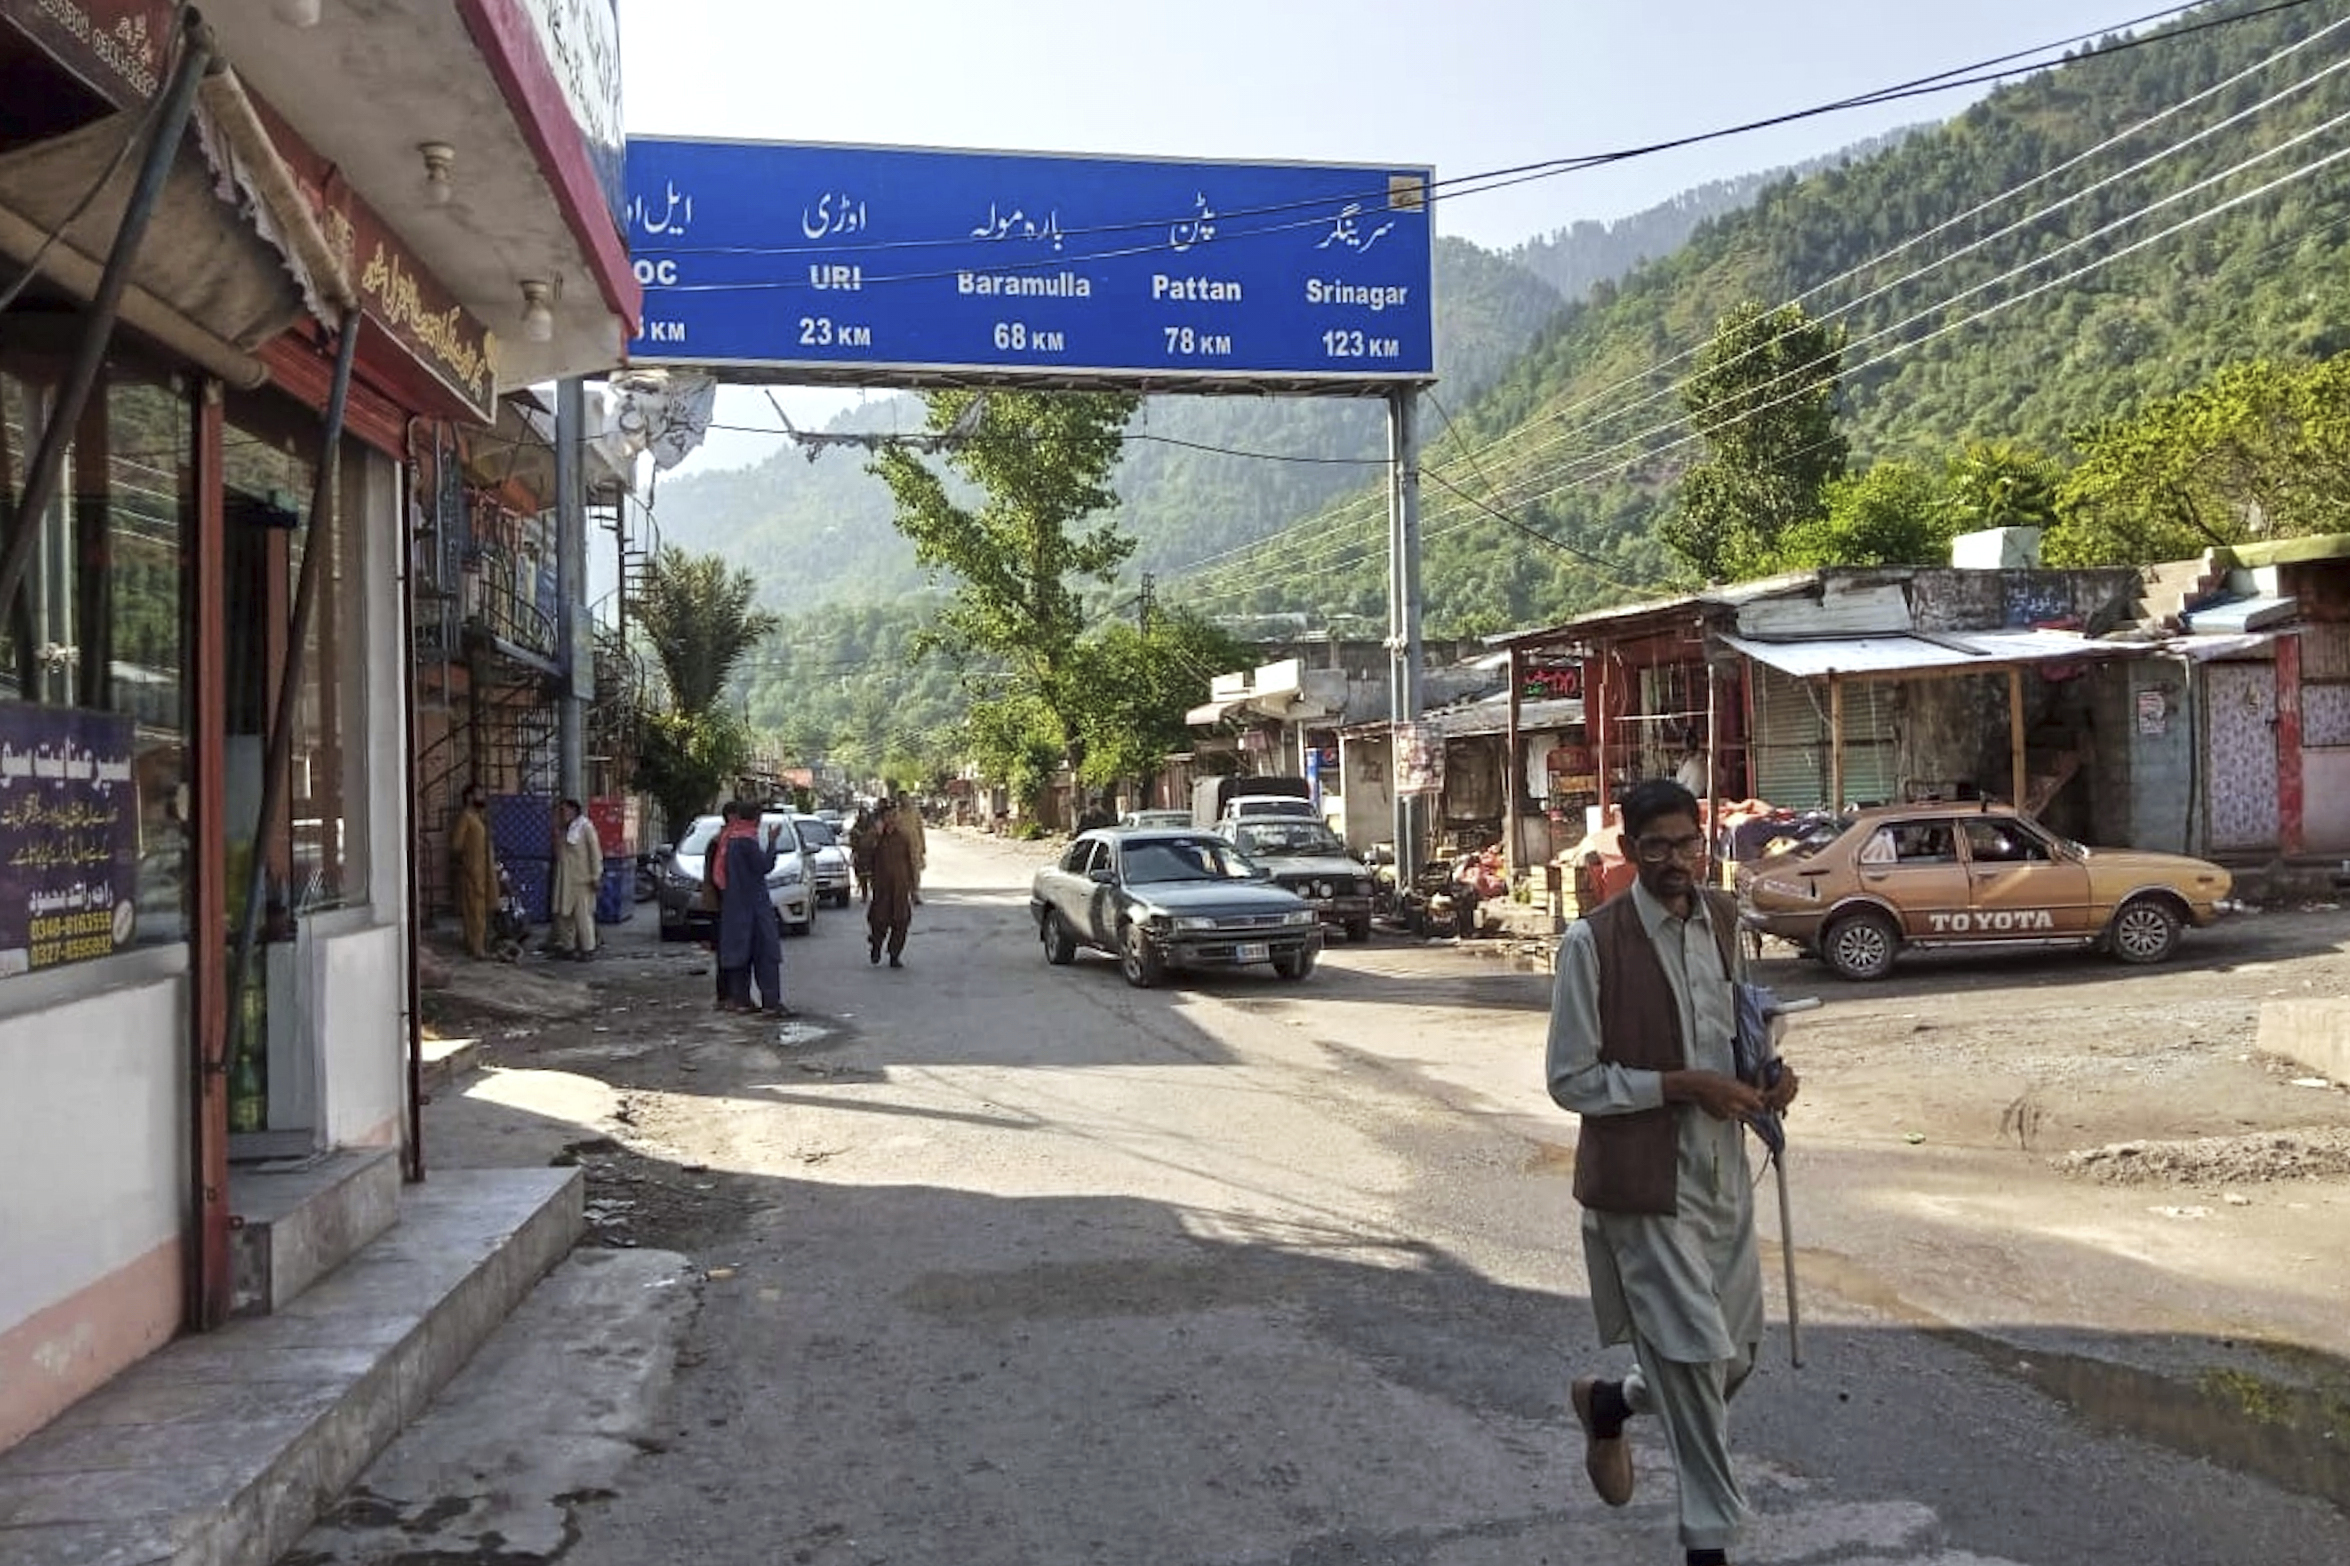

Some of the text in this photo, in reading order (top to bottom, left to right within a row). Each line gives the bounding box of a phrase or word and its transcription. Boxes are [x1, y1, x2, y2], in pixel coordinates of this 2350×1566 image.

[810, 265, 861, 290] URI
[957, 271, 1091, 298] Baramulla
[1152, 273, 1242, 304] Pattan
[1306, 279, 1407, 311] Srinagar
[650, 322, 686, 341] KM
[800, 317, 871, 346] 23 KM
[994, 323, 1064, 351] 68 KM
[1164, 327, 1231, 354] 78 KM
[1322, 330, 1399, 357] 123 KM
[1929, 909, 2054, 932] TOYOTA
